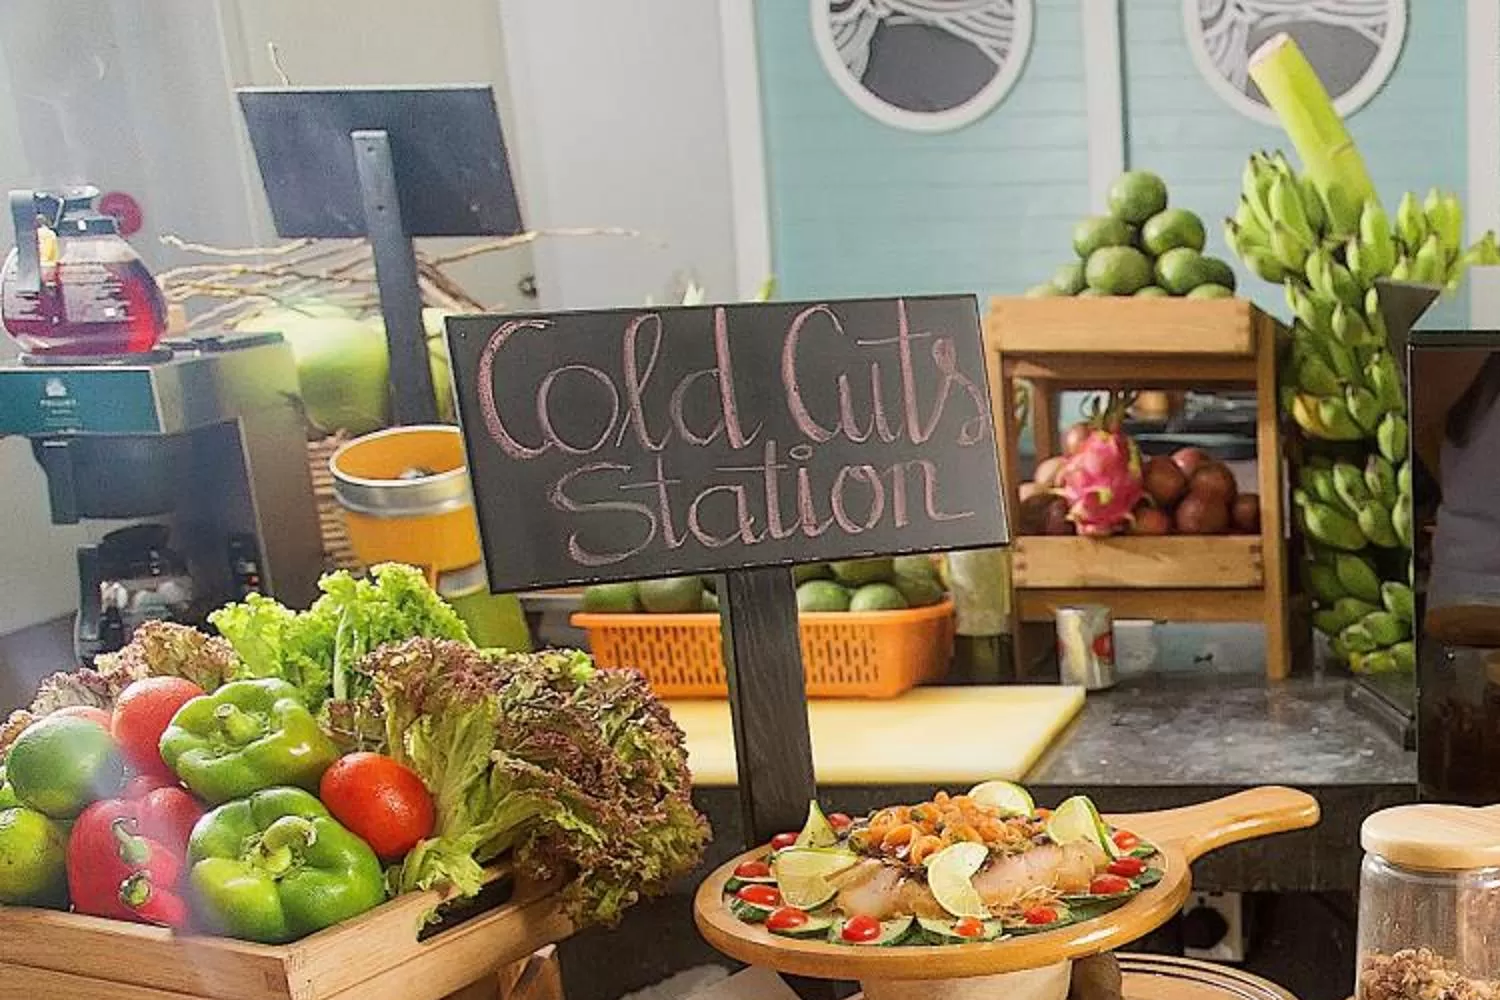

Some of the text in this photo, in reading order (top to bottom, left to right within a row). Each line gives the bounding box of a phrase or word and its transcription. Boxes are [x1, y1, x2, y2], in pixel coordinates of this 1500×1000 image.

[478, 298, 992, 460] Cold Cuts
[546, 438, 977, 567] Station
